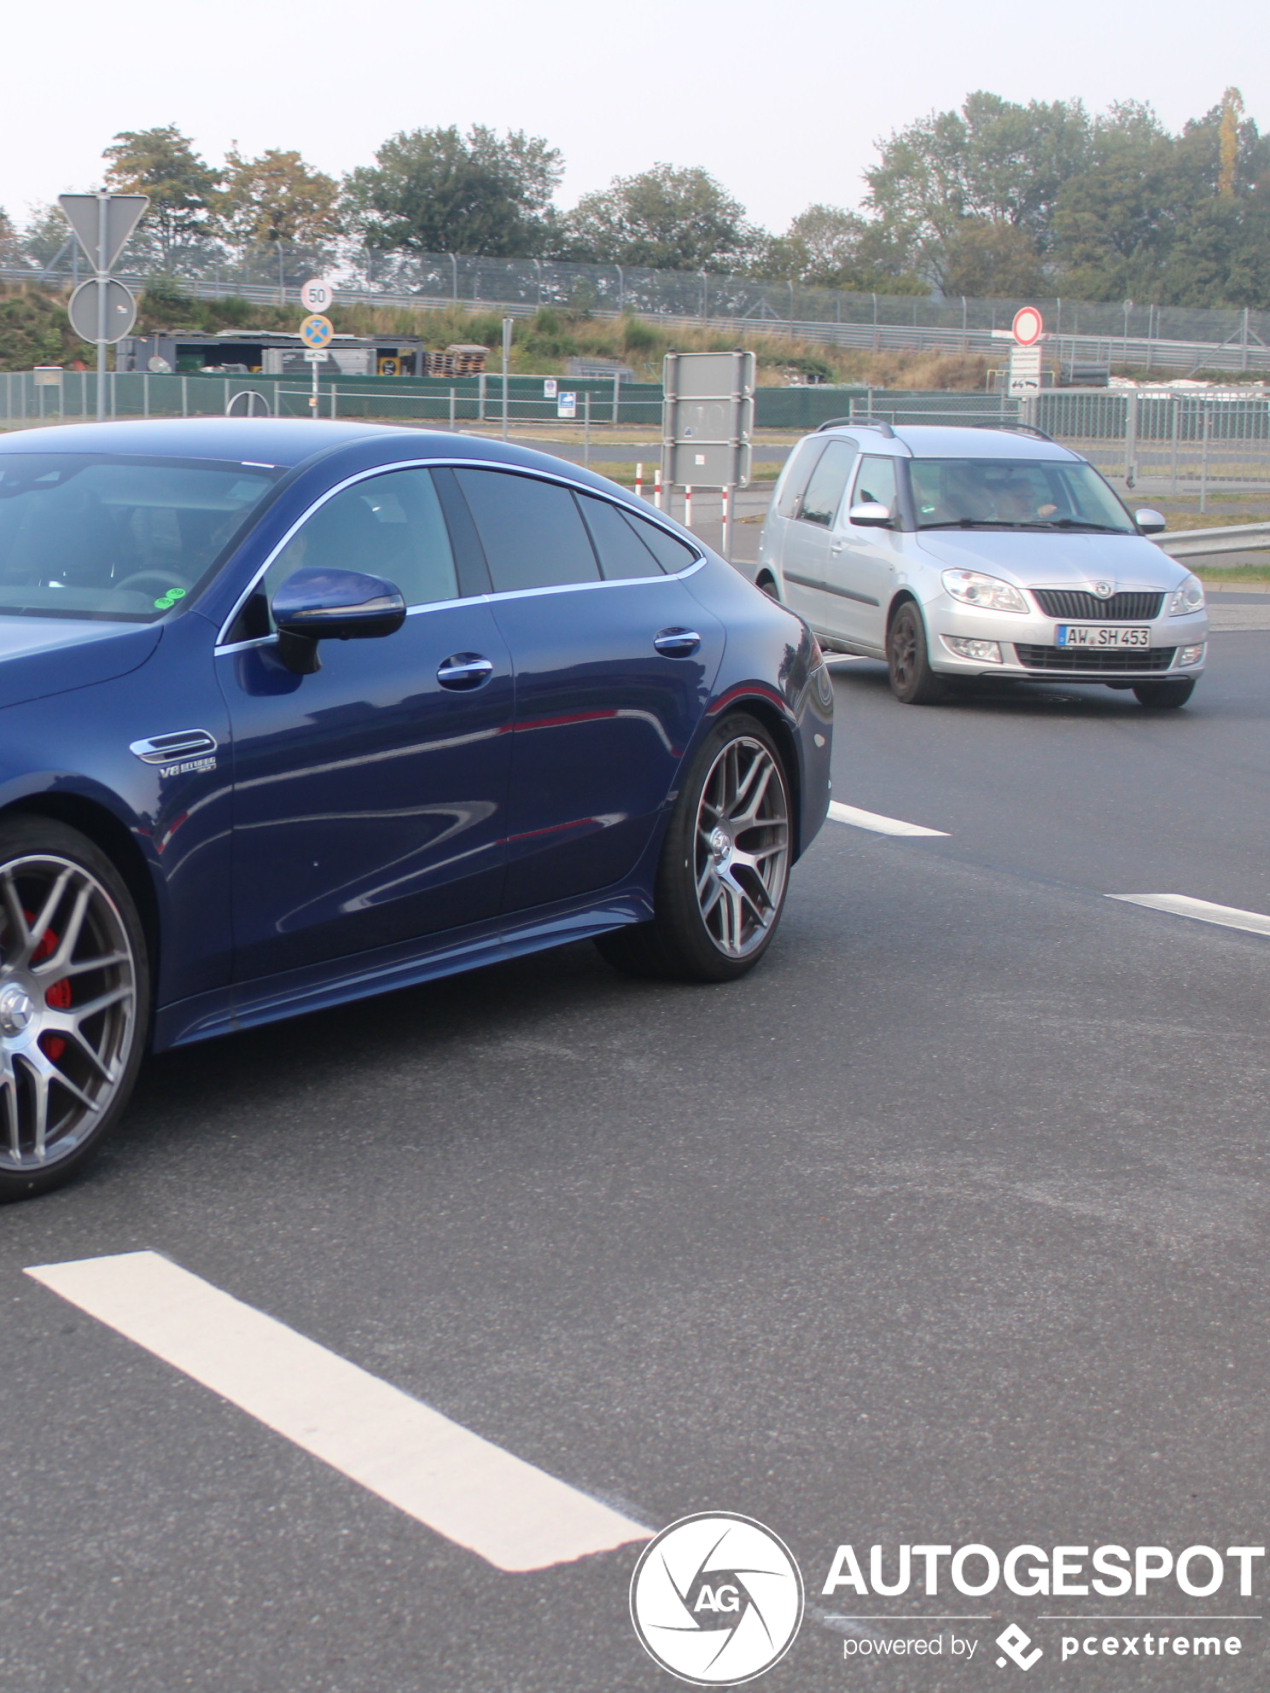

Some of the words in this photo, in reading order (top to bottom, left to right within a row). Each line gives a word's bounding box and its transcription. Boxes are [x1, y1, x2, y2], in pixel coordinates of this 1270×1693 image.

[309, 289, 326, 303] 50
[1068, 629, 1088, 643] AW
[1098, 629, 1118, 644] SH
[1121, 630, 1148, 645] 453
